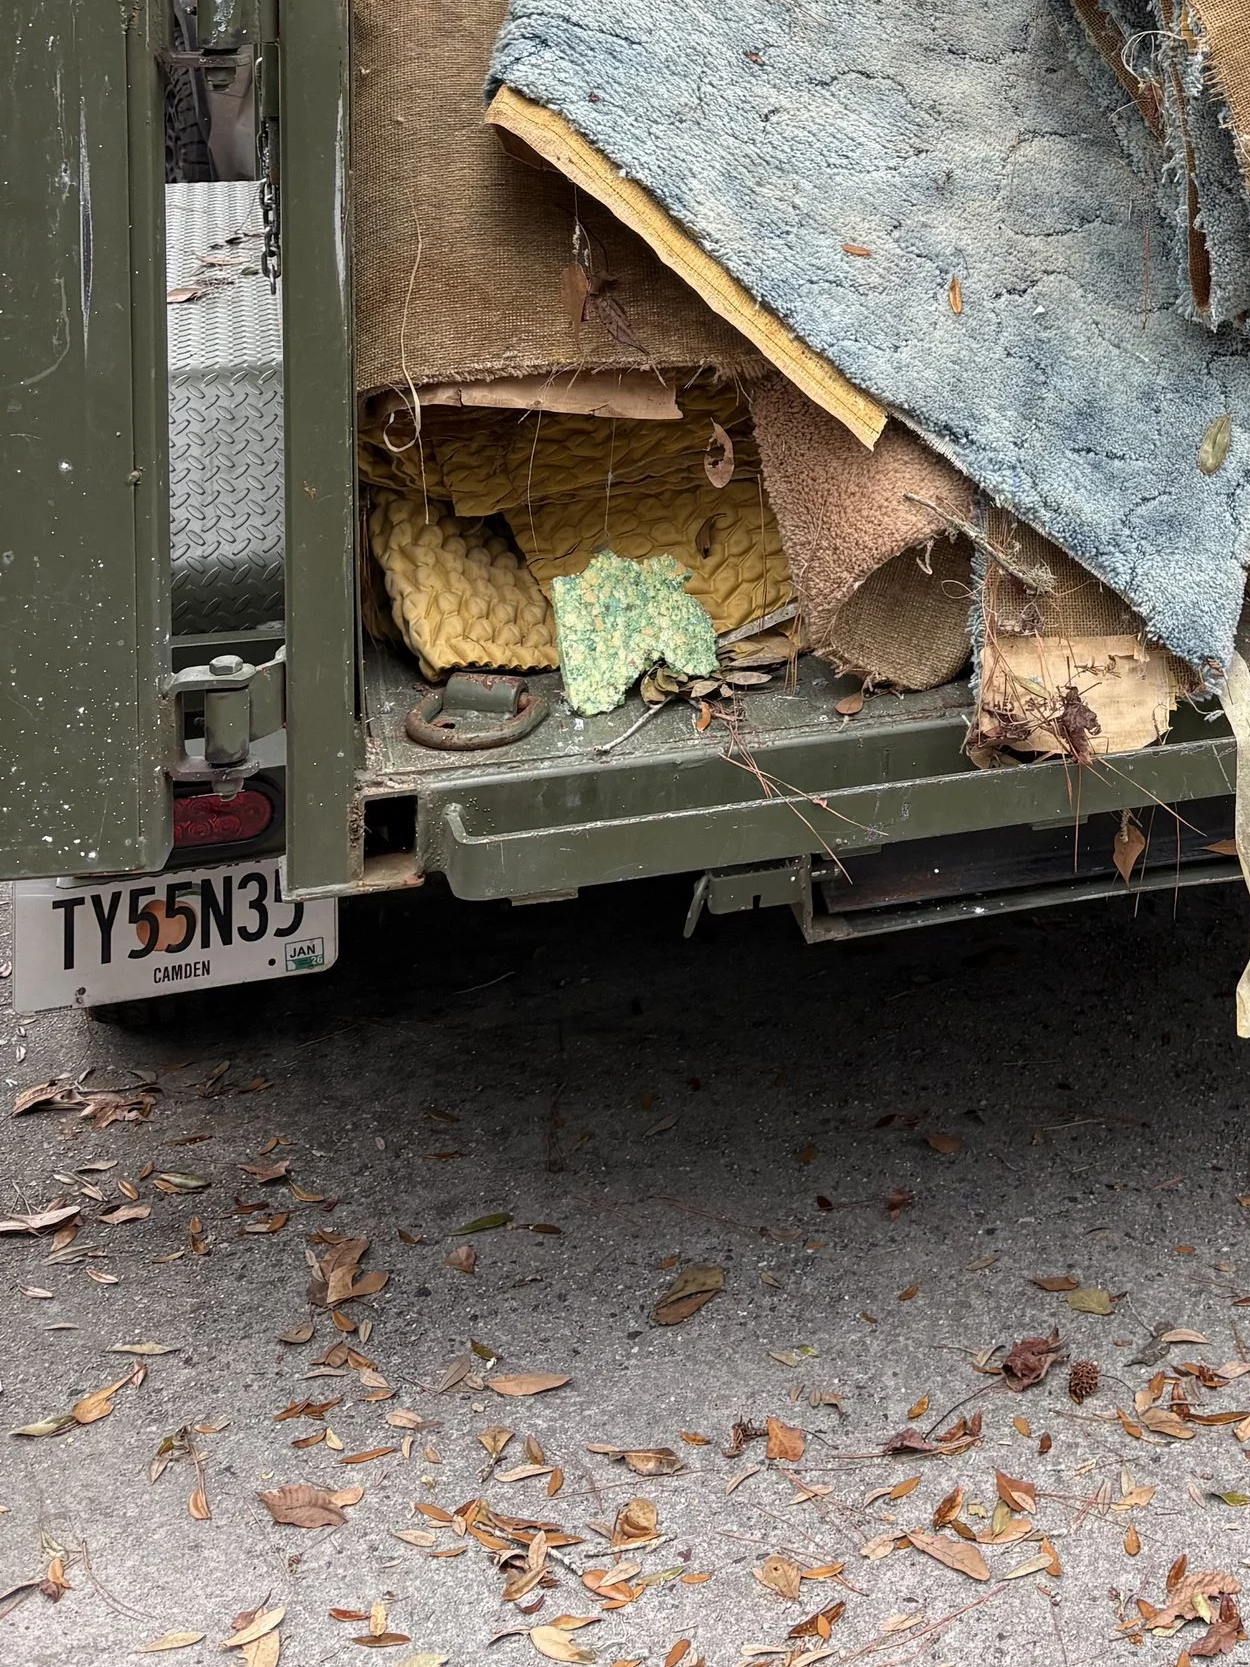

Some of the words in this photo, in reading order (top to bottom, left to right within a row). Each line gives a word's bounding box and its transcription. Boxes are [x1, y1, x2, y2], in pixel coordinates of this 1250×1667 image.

[52, 868, 304, 970] TY55N35
[289, 943, 316, 959] JAN
[310, 955, 323, 965] 26
[153, 960, 211, 984] CAMDEN
